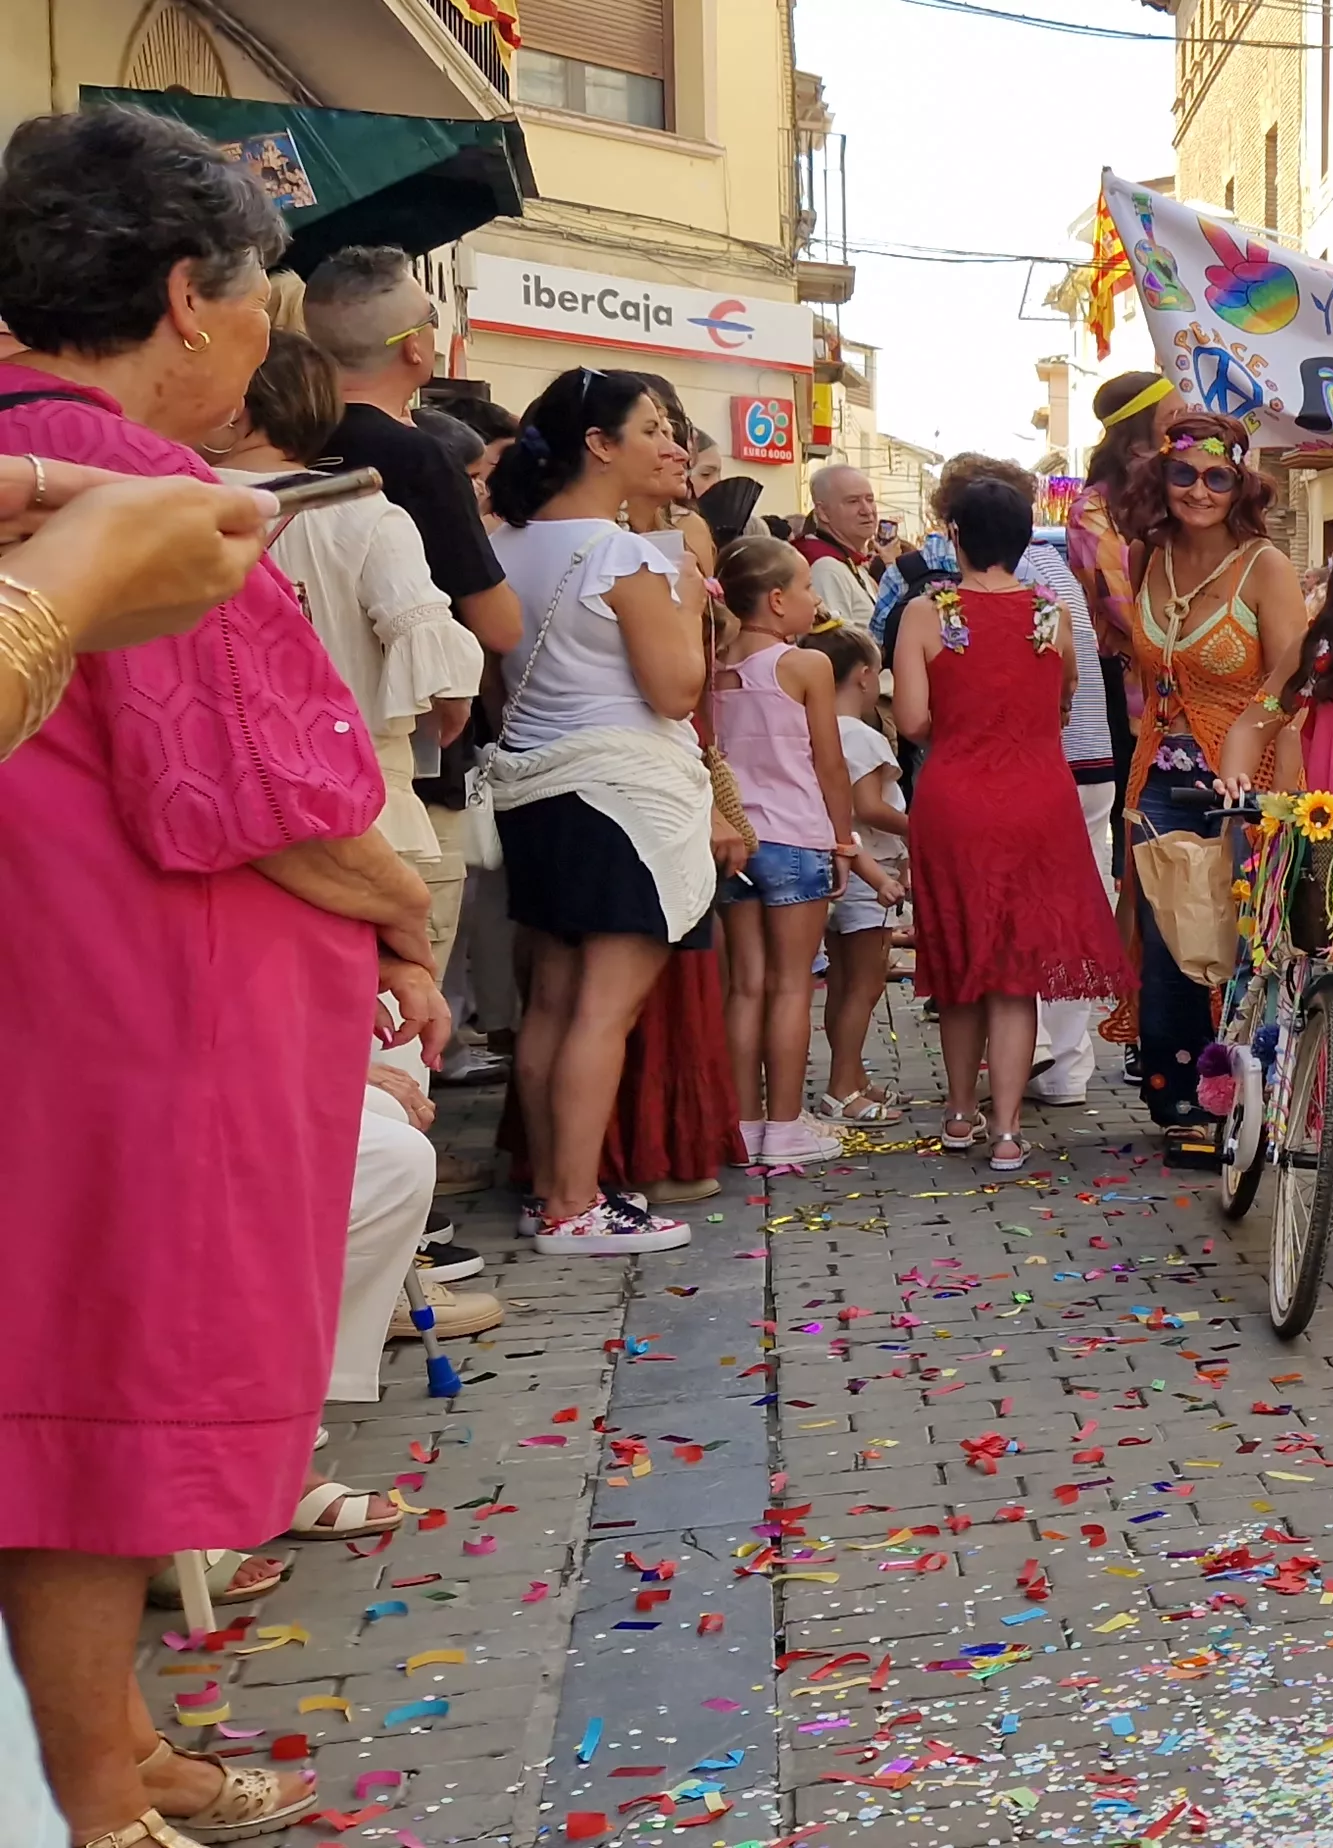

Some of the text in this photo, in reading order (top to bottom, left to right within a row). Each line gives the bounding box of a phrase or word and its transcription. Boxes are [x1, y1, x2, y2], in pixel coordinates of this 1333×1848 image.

[522, 273, 673, 333] iberCaja
[1173, 320, 1270, 378] PEACE
[743, 446, 792, 461] EURO 6000
